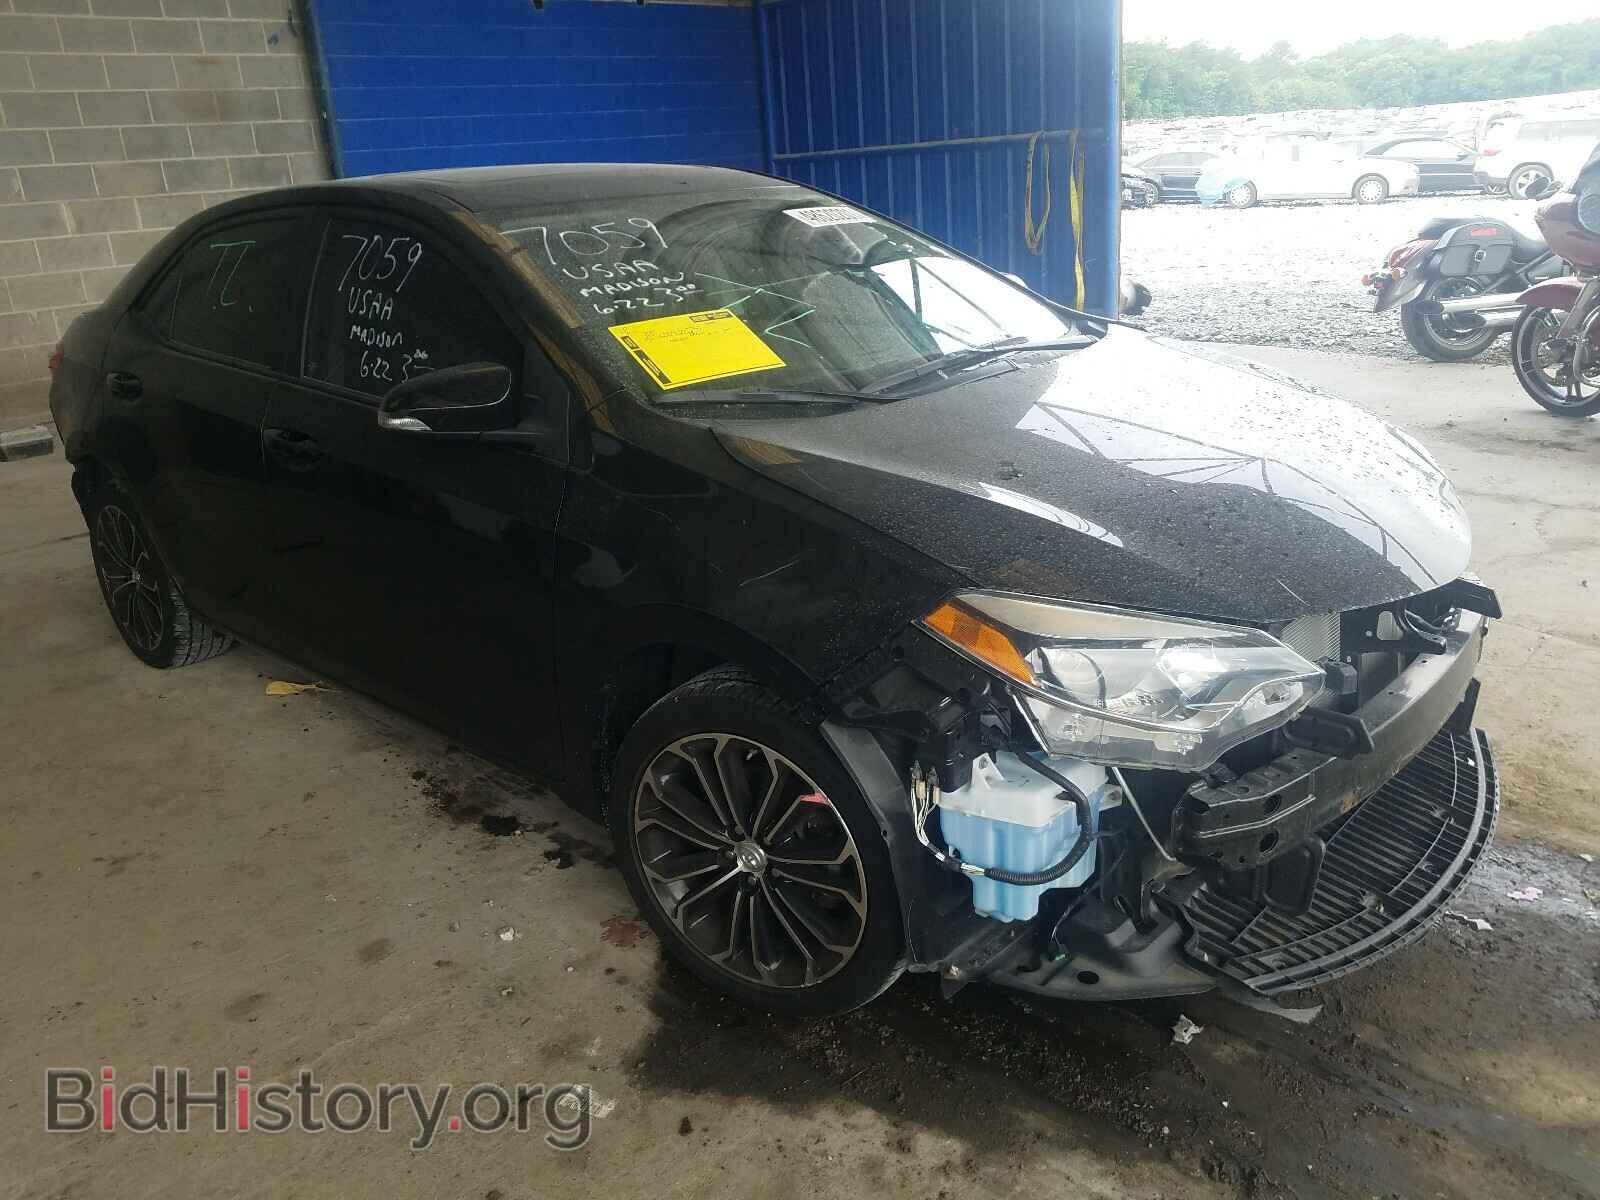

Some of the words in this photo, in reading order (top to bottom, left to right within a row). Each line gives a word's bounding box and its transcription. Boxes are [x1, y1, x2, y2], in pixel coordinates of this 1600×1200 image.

[497, 217, 669, 265] 7059
[338, 234, 423, 293] 7059
[561, 258, 660, 281] USAA
[579, 271, 686, 298] MADISON
[348, 286, 394, 320] USAA
